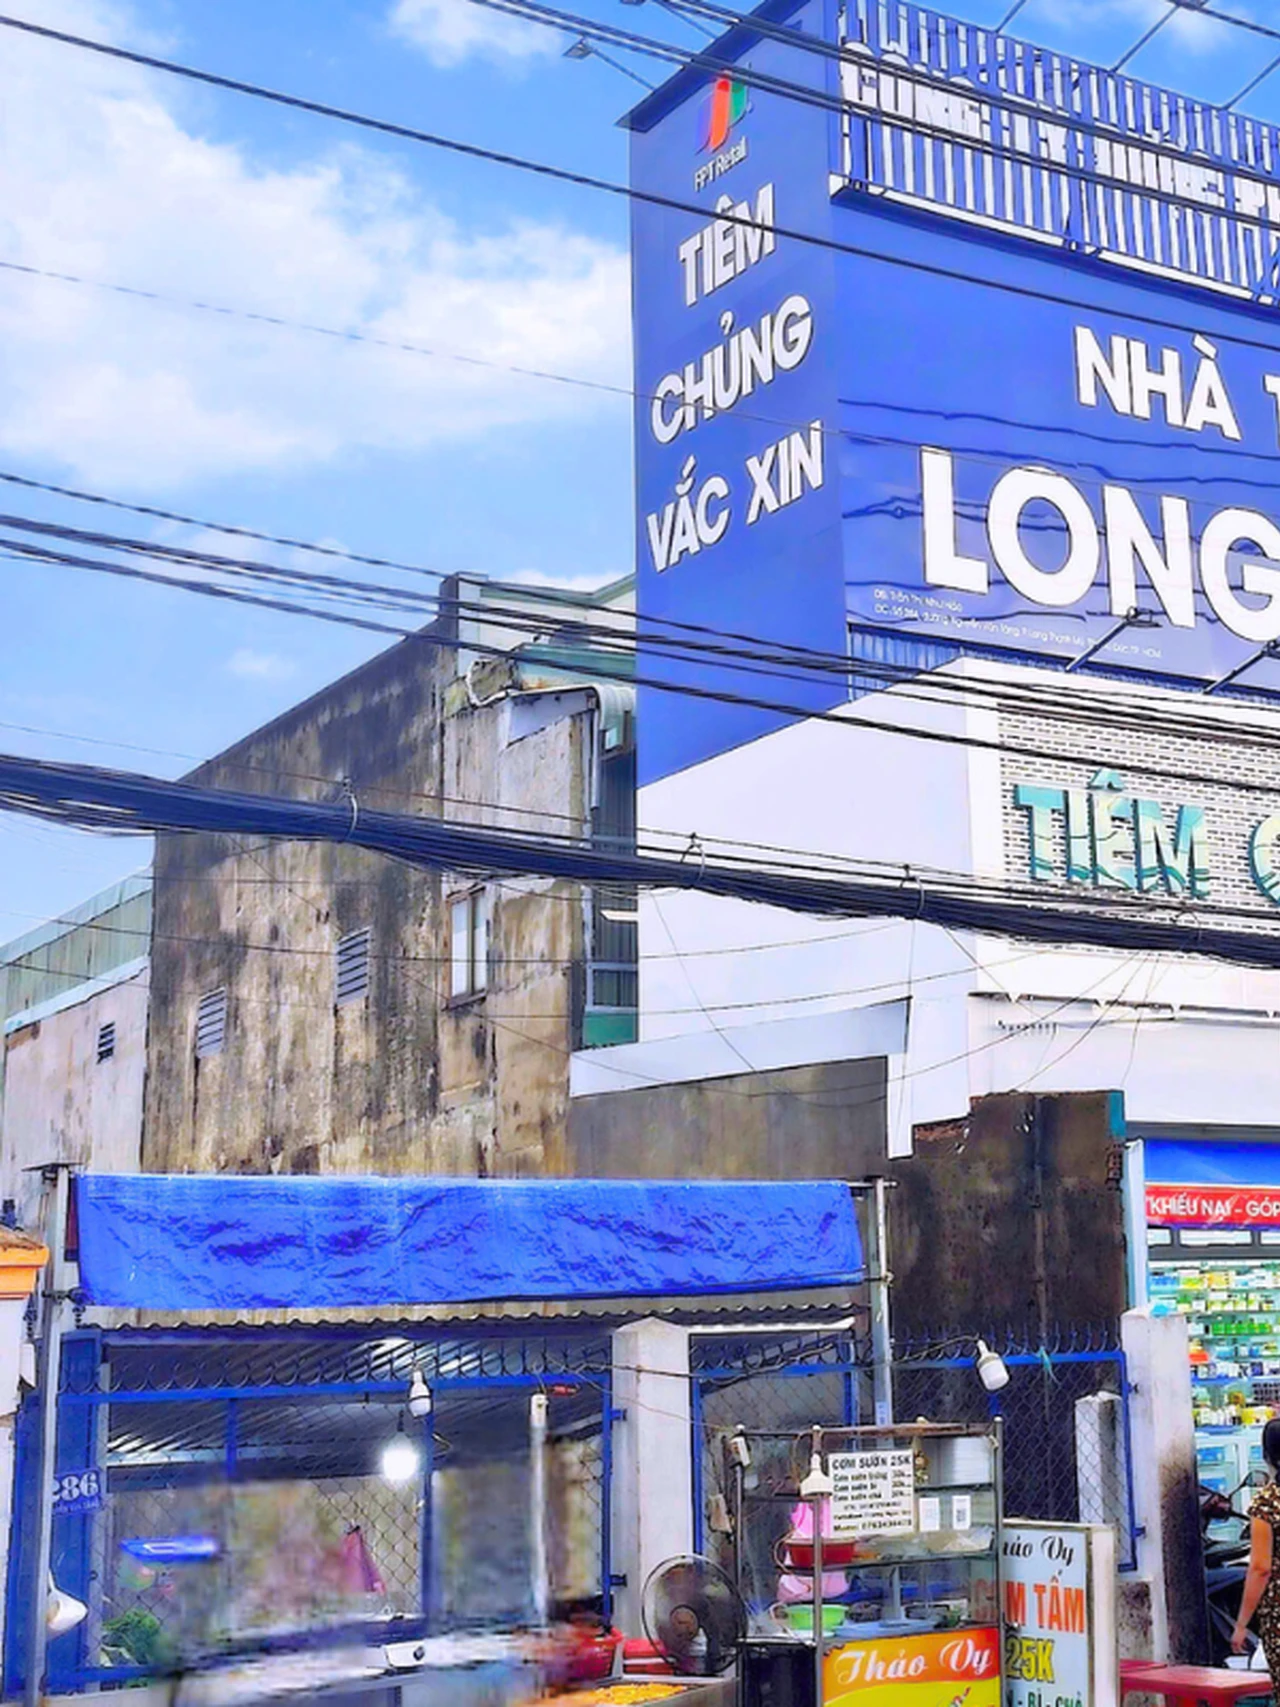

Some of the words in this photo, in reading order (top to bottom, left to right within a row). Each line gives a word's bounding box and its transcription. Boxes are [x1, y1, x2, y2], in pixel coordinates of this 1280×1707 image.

[679, 184, 776, 307] TIÊM
[651, 295, 814, 445] CHỦNG
[1074, 325, 1242, 441] NHÀ
[647, 456, 731, 573] VẮC
[745, 420, 824, 526] XIN
[1014, 769, 1210, 899] TIÊM
[1149, 1192, 1198, 1216] KHIẾU
[890, 1454, 911, 1467] 25K
[1033, 1569, 1085, 1634] TẤM
[835, 1648, 929, 1685] Thảo
[939, 1638, 993, 1676] Vy
[1006, 1633, 1055, 1684] 25K
